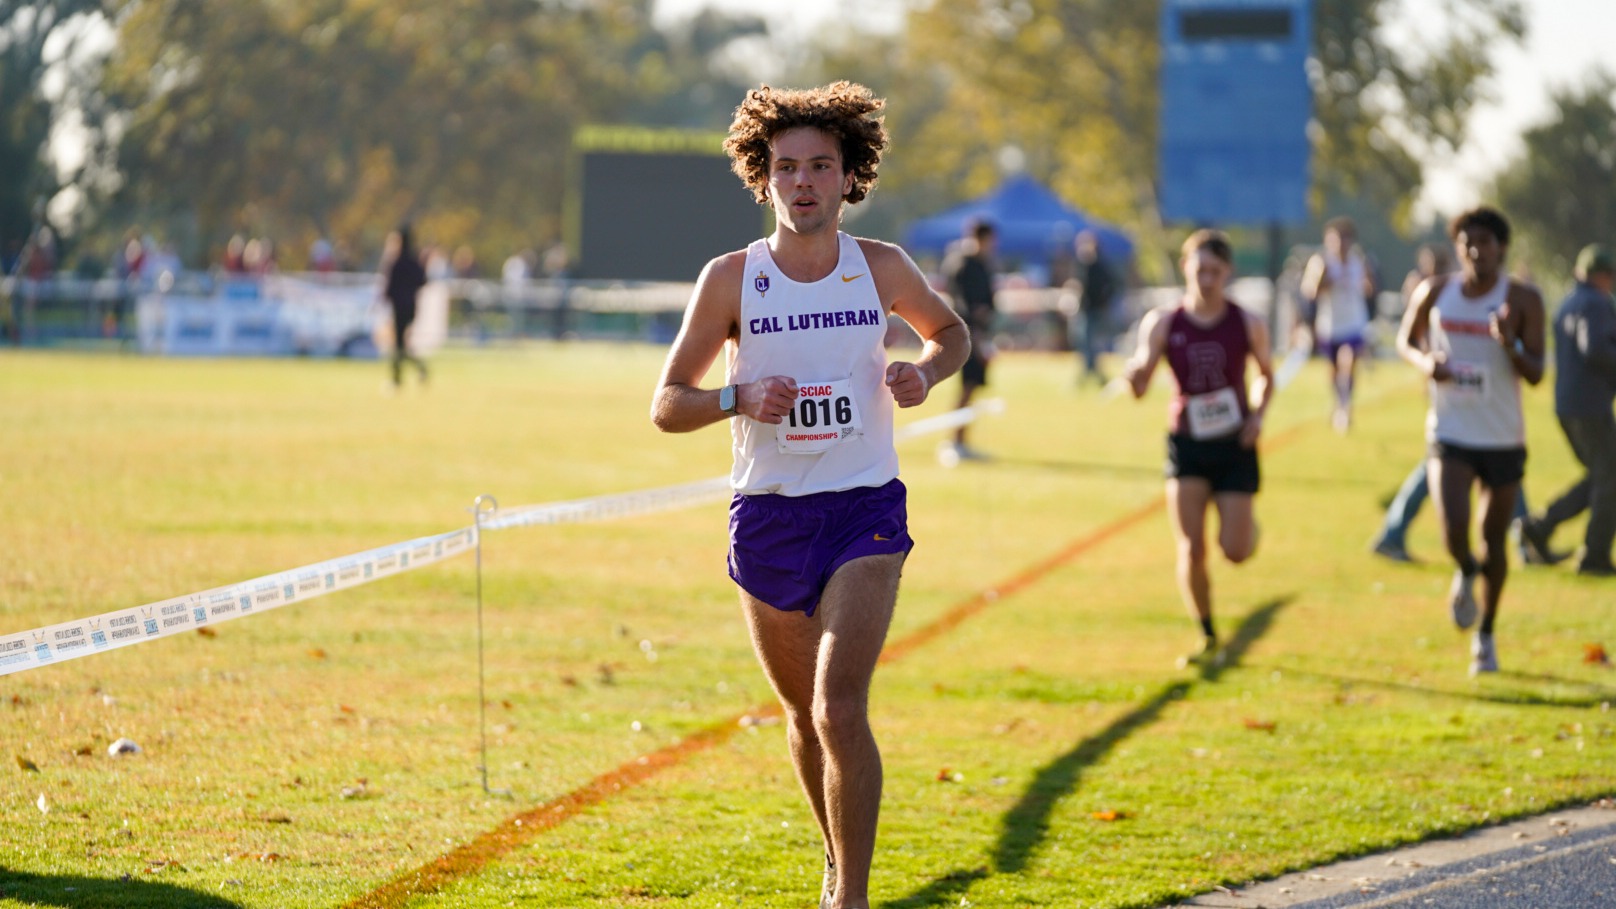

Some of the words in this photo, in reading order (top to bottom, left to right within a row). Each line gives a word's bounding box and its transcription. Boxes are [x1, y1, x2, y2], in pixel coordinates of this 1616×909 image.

[757, 278, 768, 291] CL
[750, 316, 783, 335] CAL
[788, 310, 880, 331] LUTHERAN
[800, 385, 832, 397] SCIAC
[788, 395, 852, 428] 1016
[786, 432, 838, 441] CHAMPIONSHIPS
